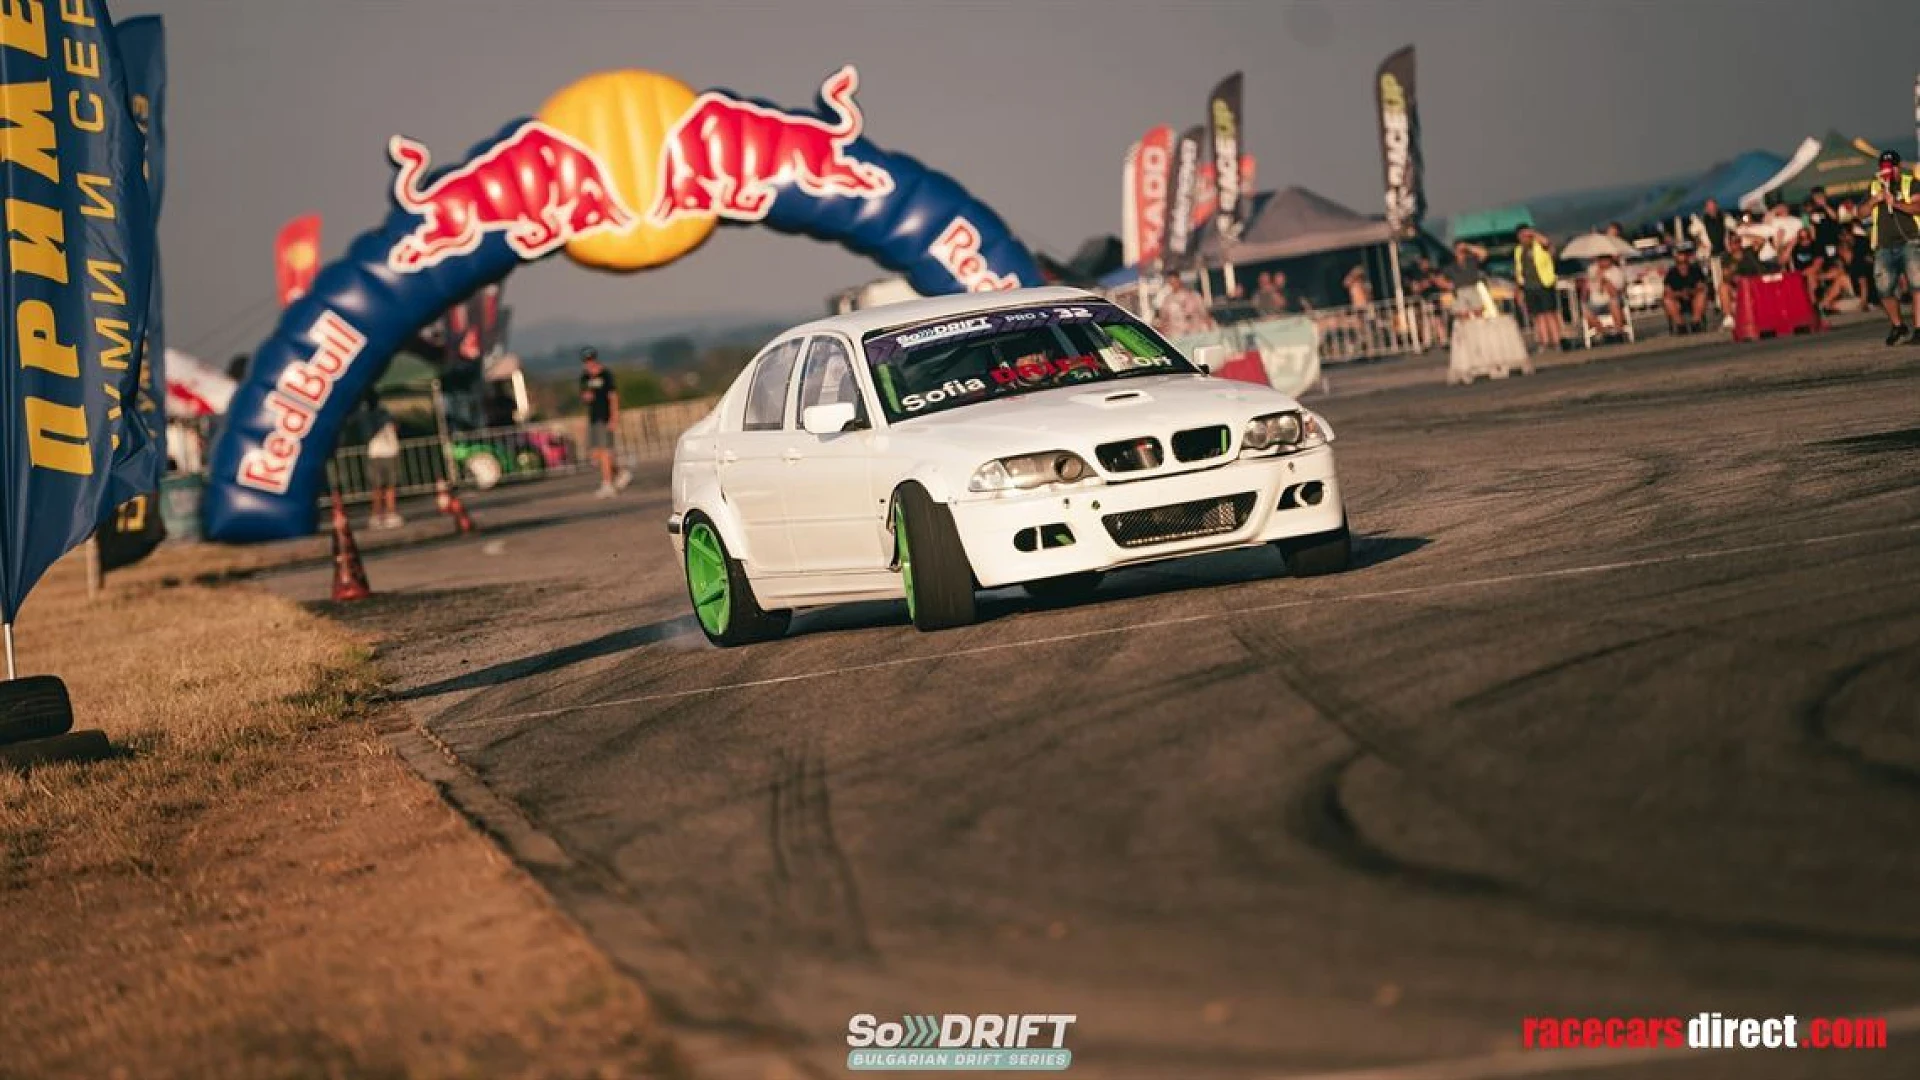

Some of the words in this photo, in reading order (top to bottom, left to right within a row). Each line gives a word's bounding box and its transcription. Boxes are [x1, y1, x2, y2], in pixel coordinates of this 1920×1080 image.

[241, 403, 309, 490] Red
[282, 314, 366, 404] Bull
[902, 378, 985, 412] Sofia
